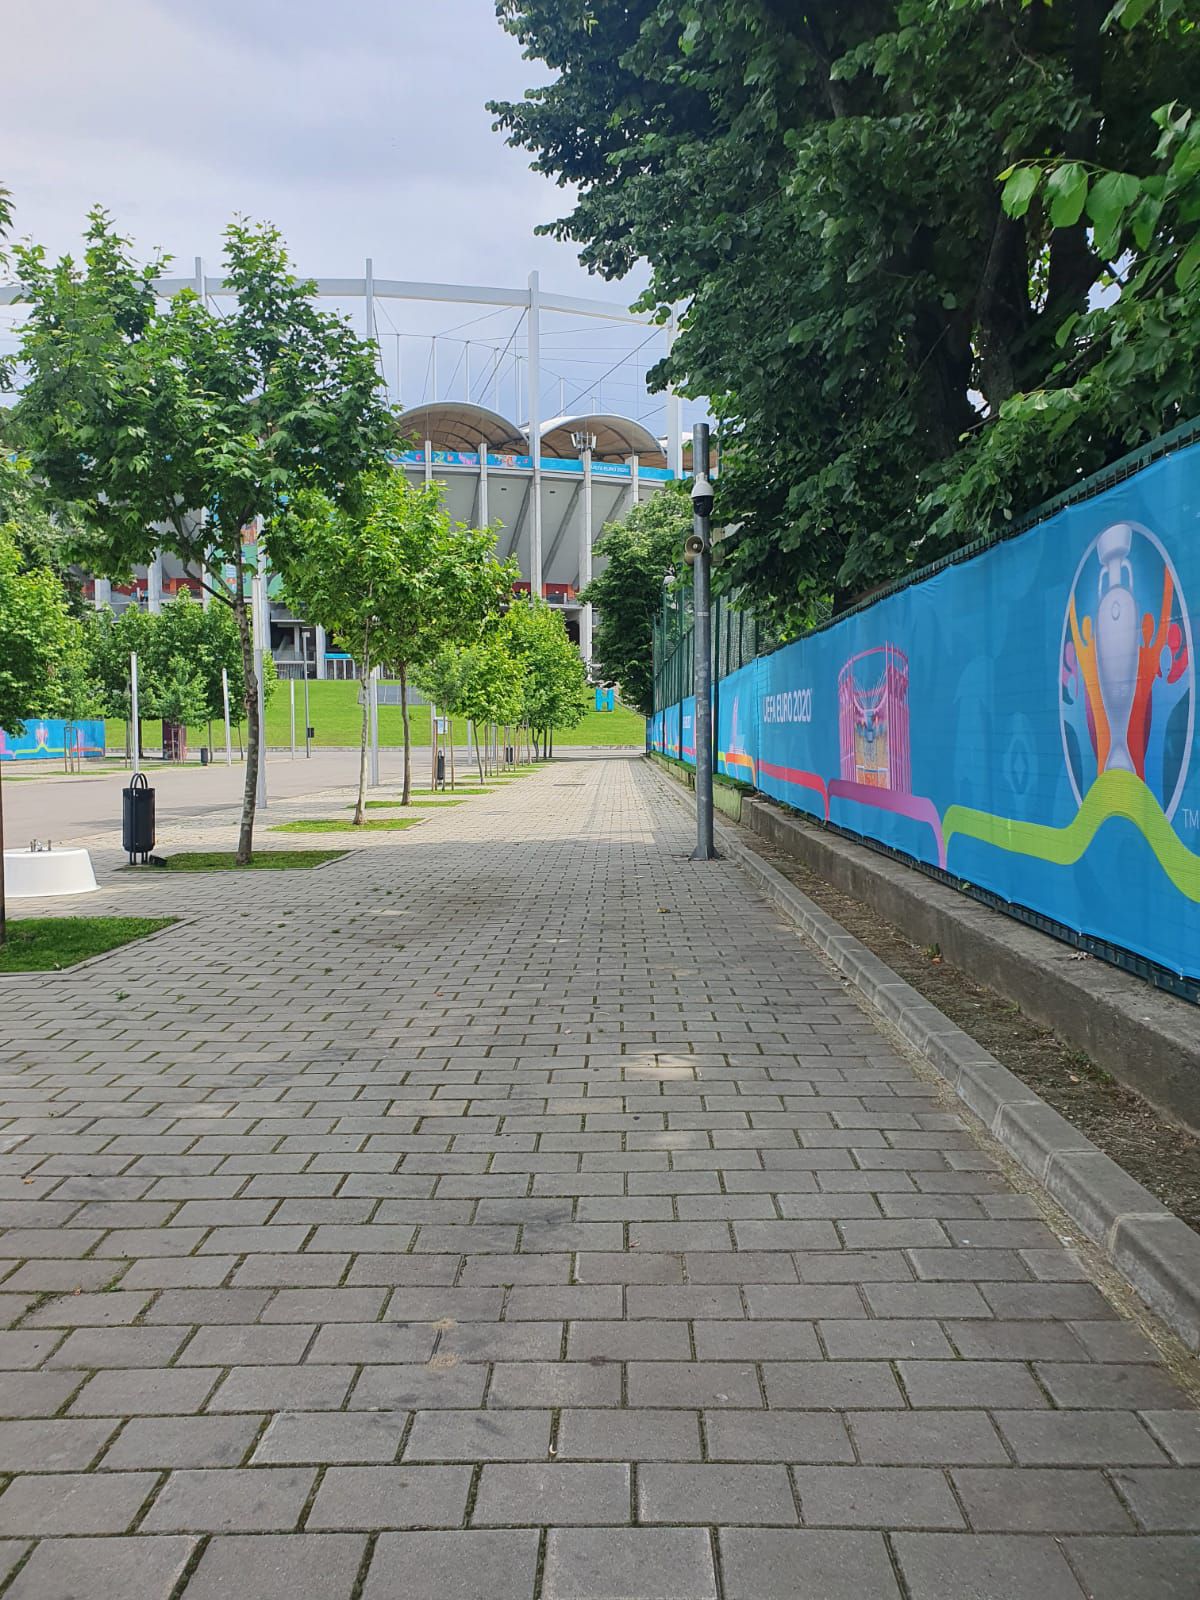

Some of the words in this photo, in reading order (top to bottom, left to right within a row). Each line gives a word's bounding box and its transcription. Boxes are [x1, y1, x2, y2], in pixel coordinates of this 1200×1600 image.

[763, 695, 777, 723] UEFA
[777, 691, 793, 722] EURO
[793, 688, 812, 722] 2020
[1181, 808, 1200, 830] TM
